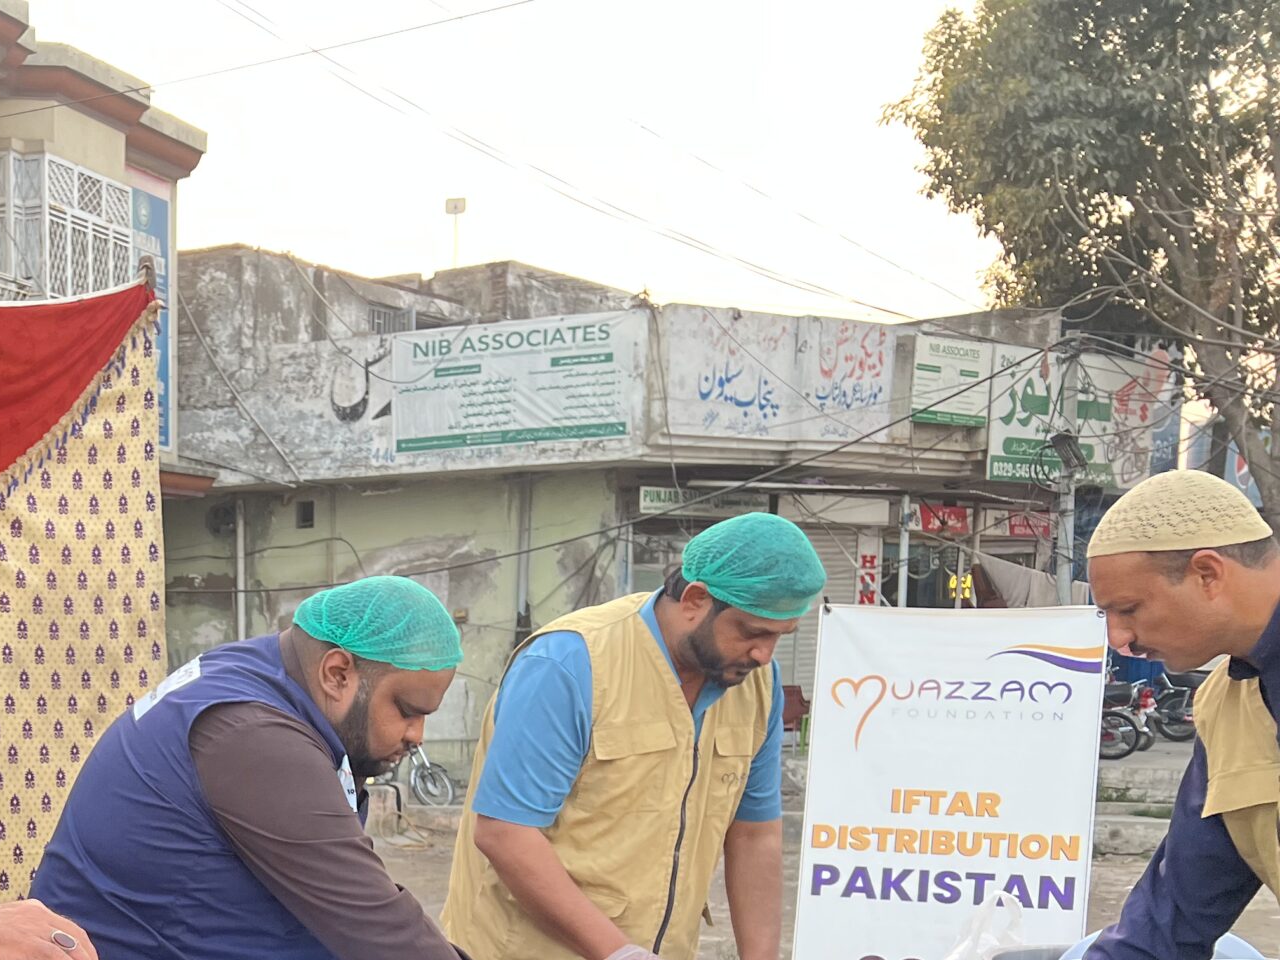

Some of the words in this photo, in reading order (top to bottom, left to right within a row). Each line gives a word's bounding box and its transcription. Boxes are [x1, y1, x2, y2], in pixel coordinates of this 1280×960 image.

[412, 338, 452, 359] NIB
[460, 323, 611, 354] ASSOCIATES
[929, 342, 941, 354] NIB
[942, 345, 981, 359] ASSOCIATES
[698, 357, 745, 401] سیلون
[734, 367, 780, 420] پنجاب
[643, 489, 679, 504] PUNJAB
[831, 674, 1073, 751] MUAZZAM
[891, 708, 1065, 722] FOUNDATION
[890, 788, 1002, 818] IFTAR
[810, 823, 1081, 862] DISTRIBUTION
[810, 863, 1076, 911] PAKISTAN
